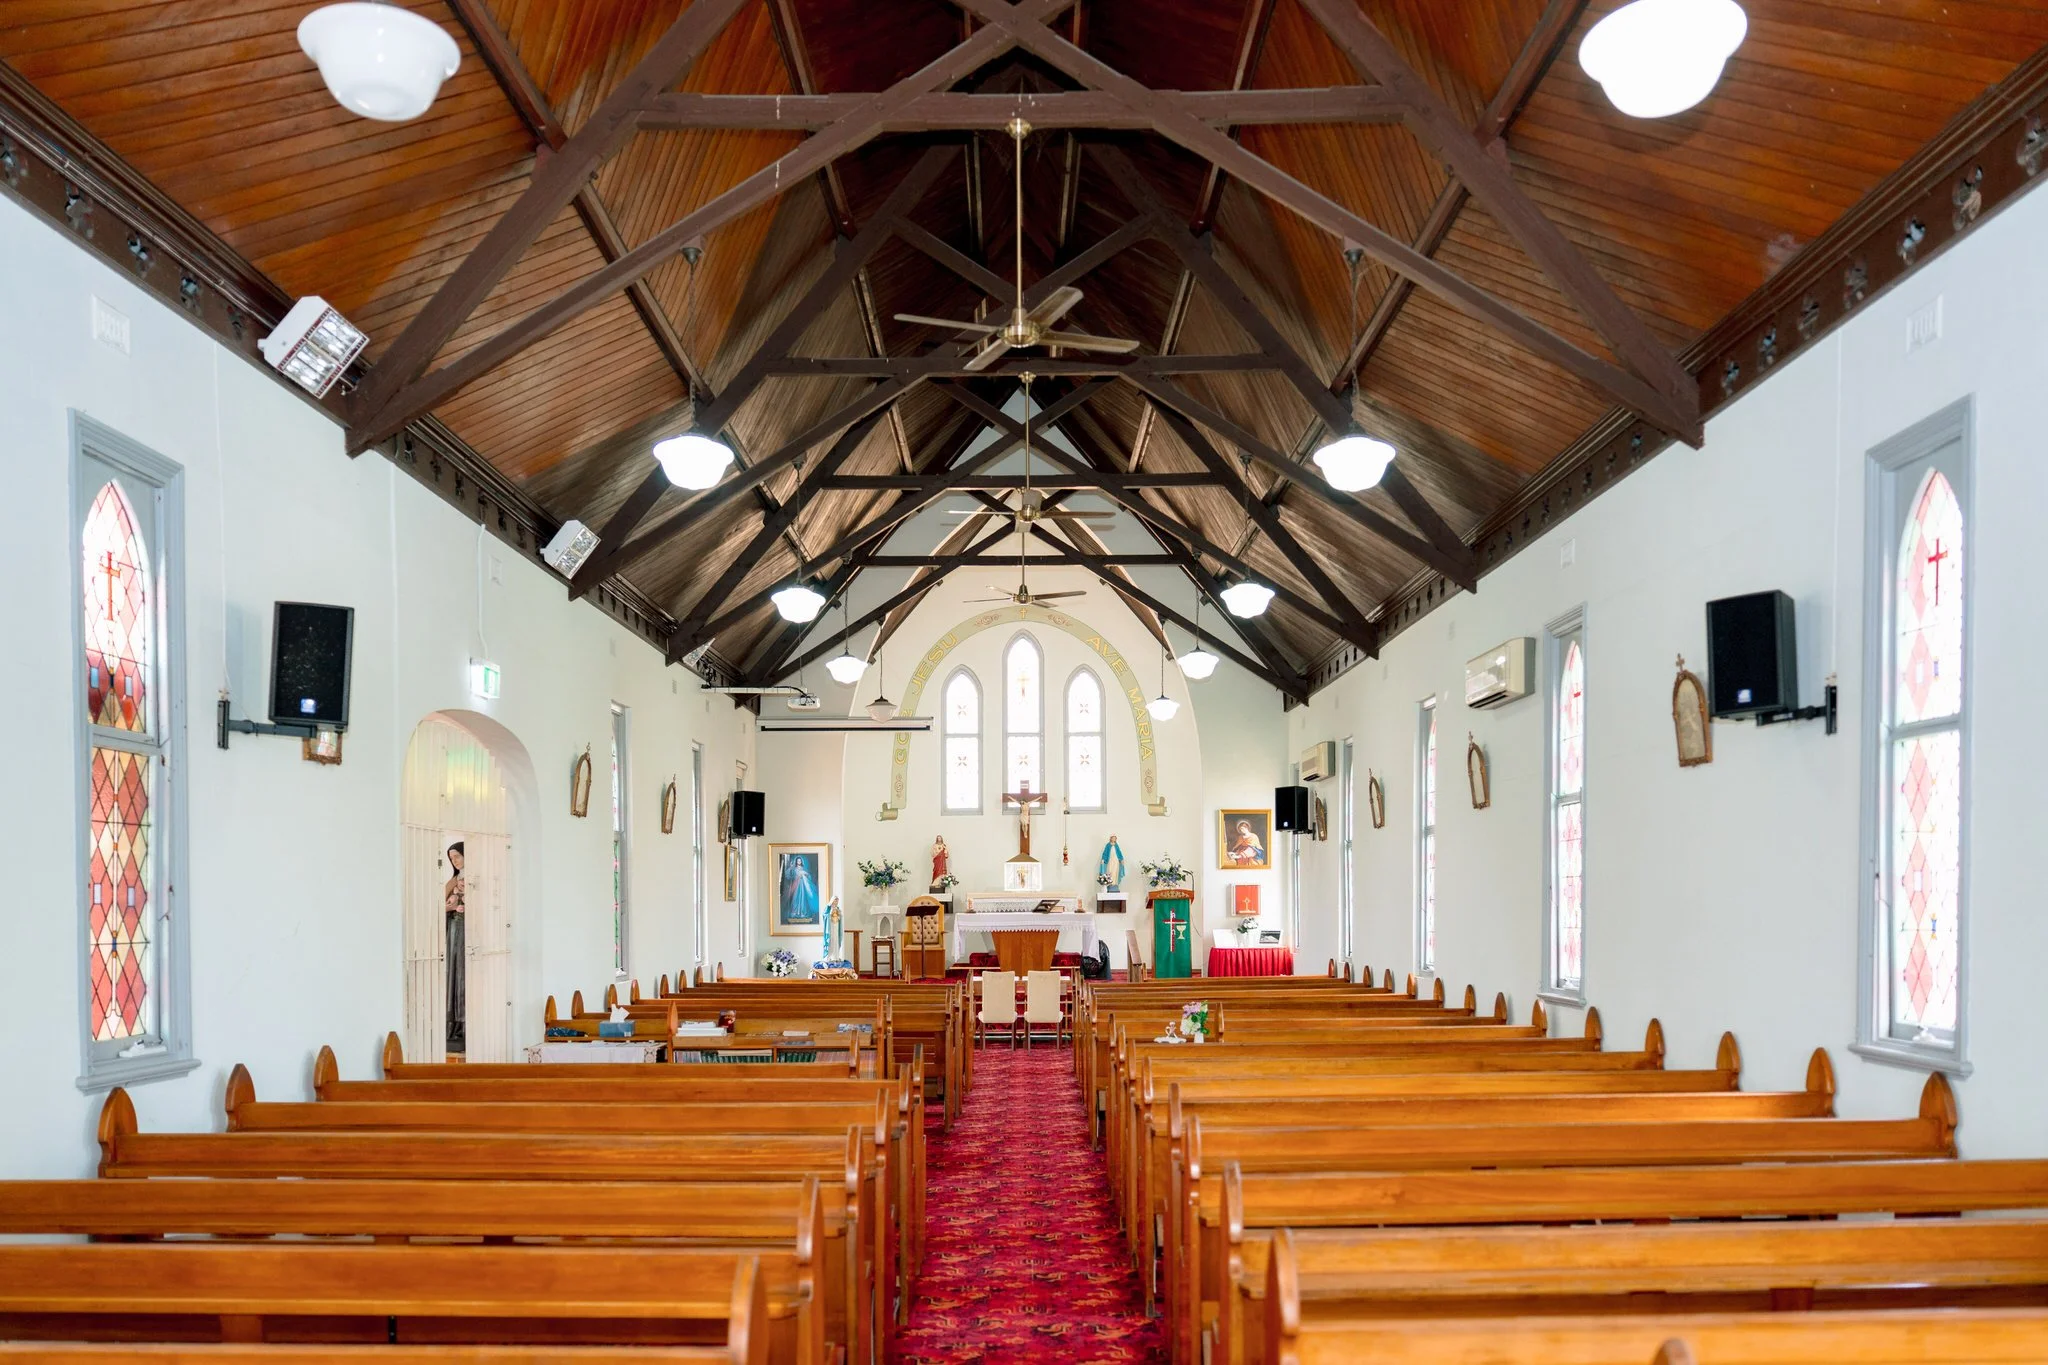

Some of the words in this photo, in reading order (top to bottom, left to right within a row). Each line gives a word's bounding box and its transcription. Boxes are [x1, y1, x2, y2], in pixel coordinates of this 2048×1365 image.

[911, 632, 959, 695] JESU
[1086, 636, 1129, 676] AVE
[1127, 687, 1153, 761] MARIA
